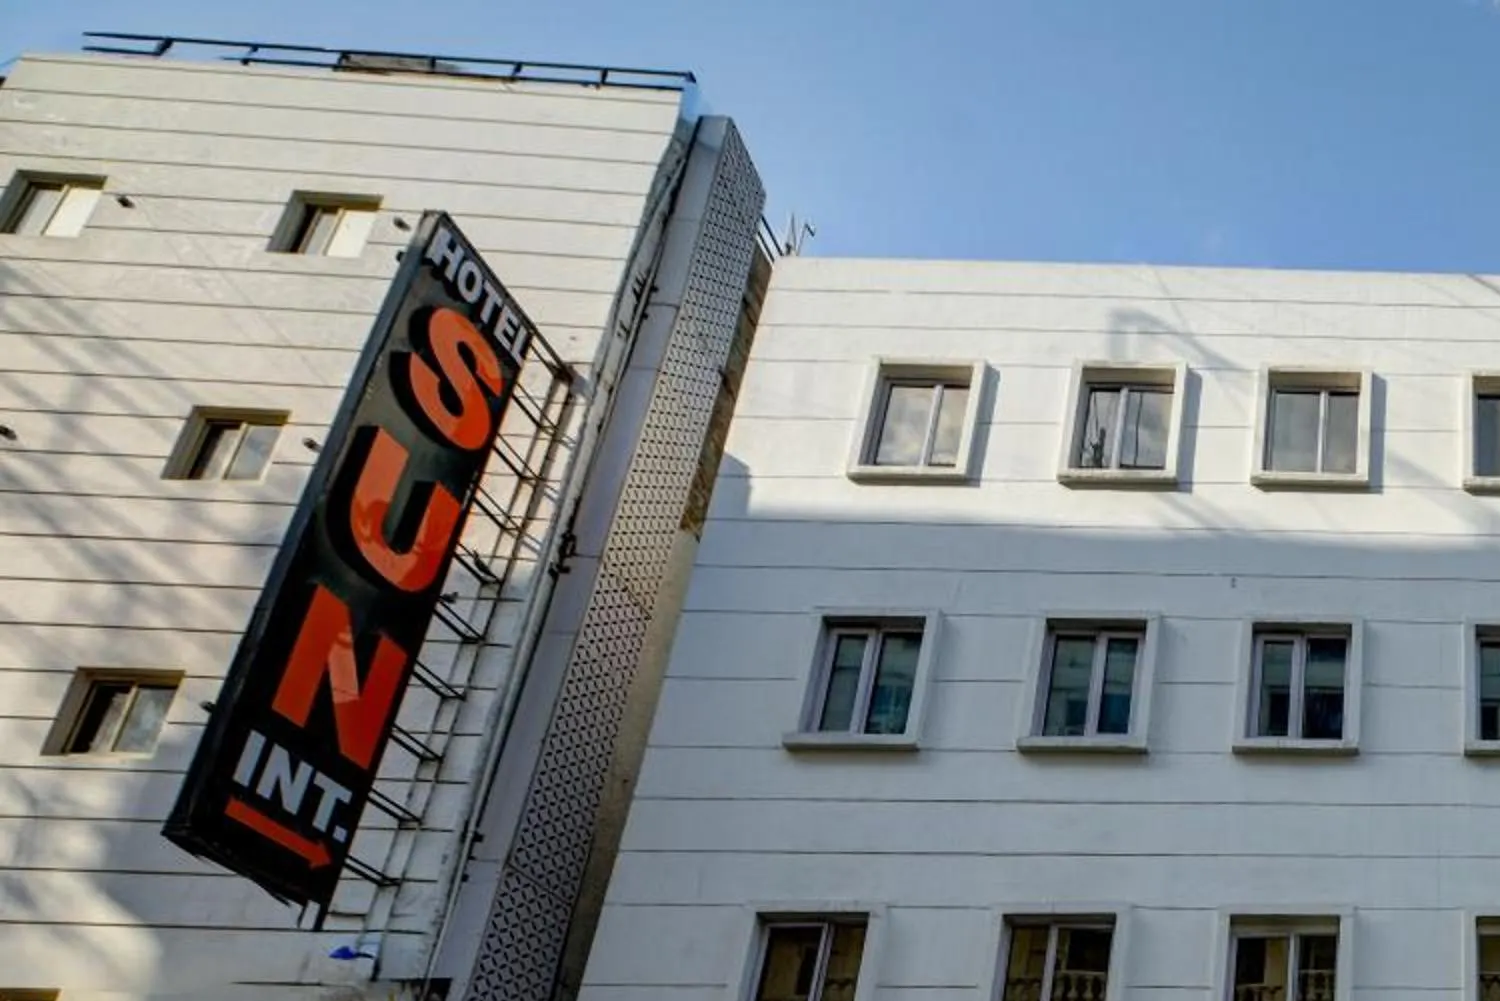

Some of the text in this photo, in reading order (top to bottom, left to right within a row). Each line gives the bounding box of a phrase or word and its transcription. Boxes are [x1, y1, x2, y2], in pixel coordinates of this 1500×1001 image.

[428, 227, 531, 367] HOTEL
[271, 305, 504, 771] SUN
[233, 729, 353, 843] INT.
